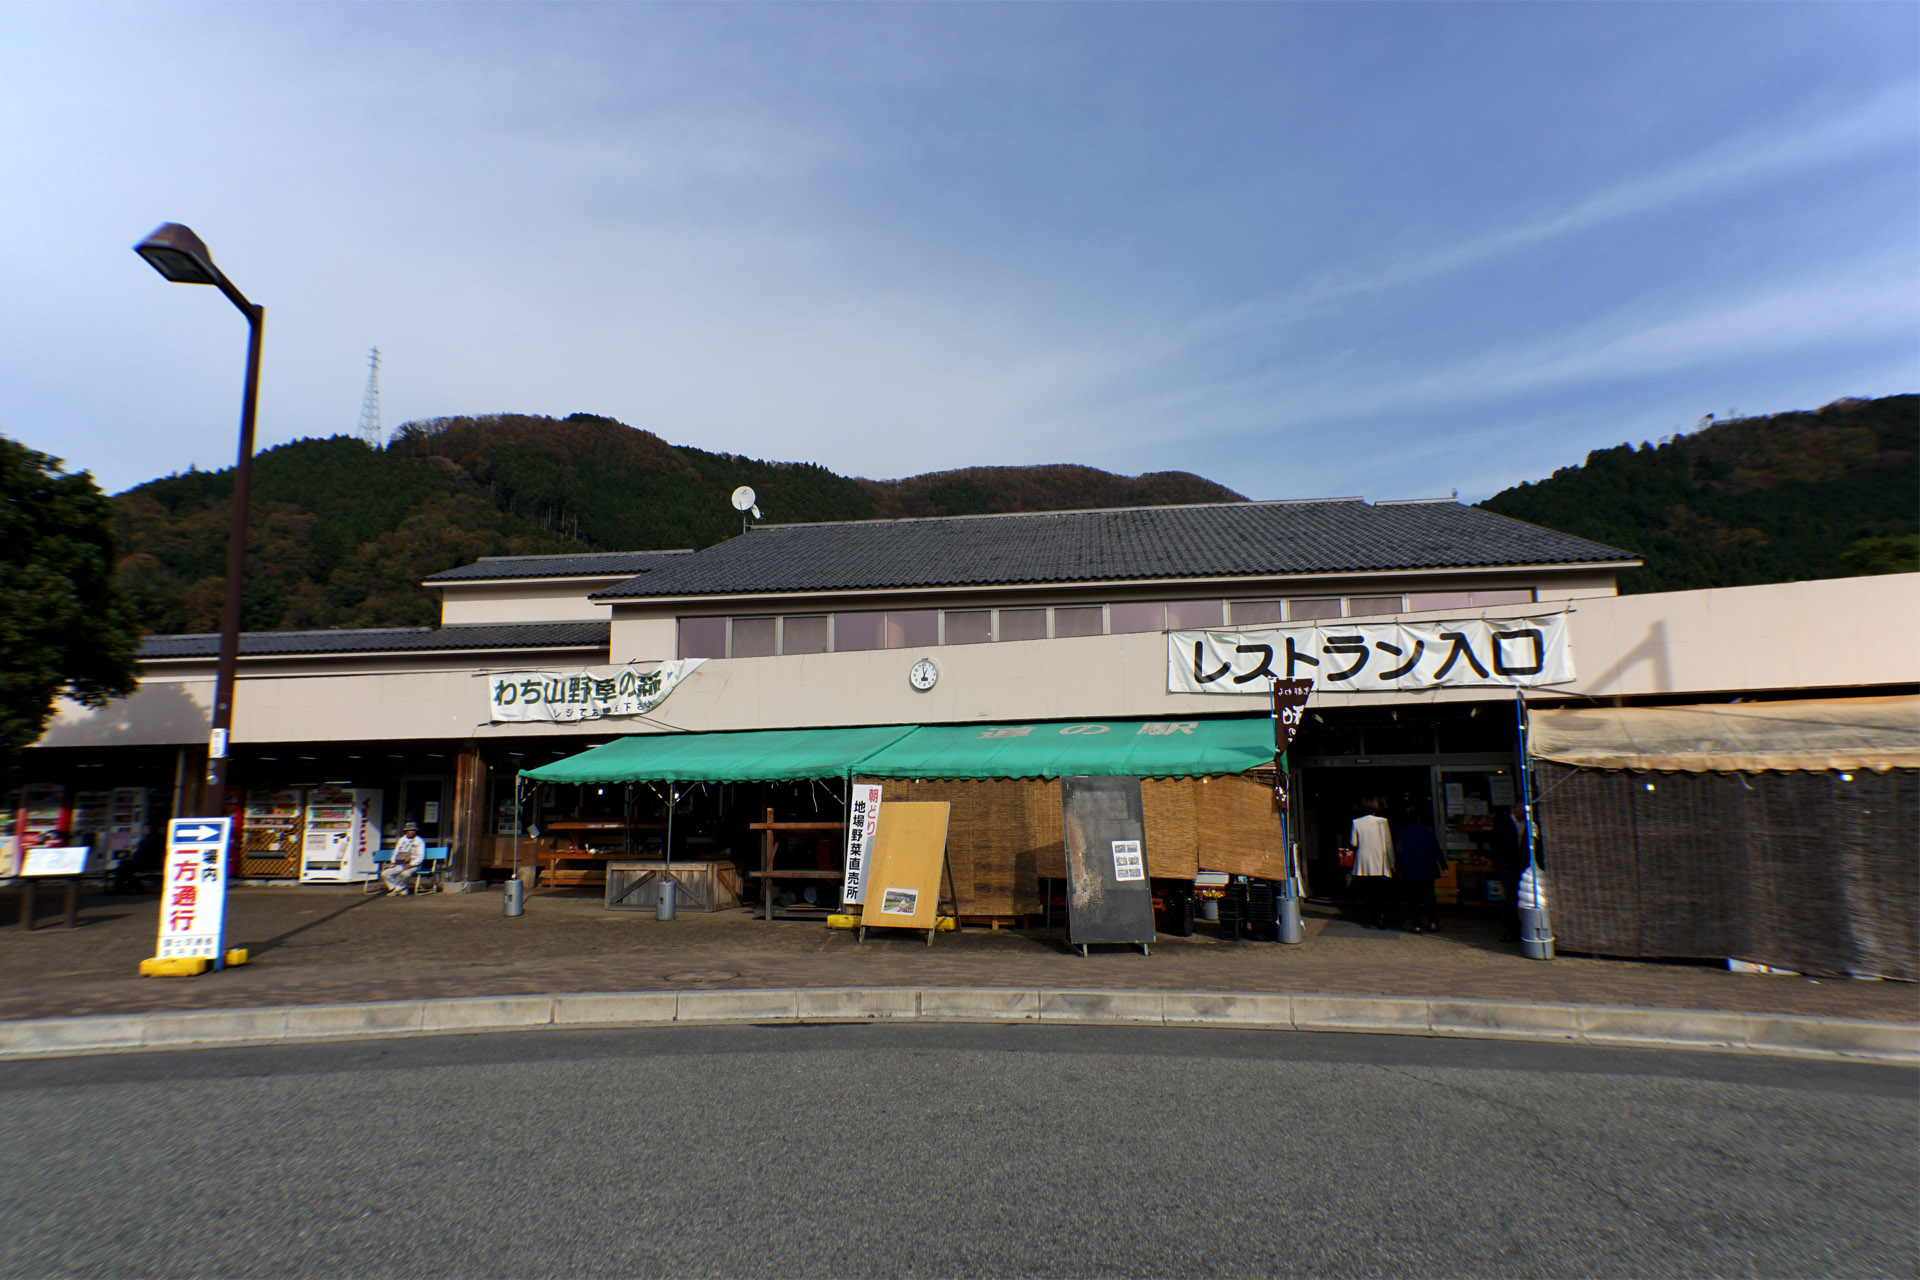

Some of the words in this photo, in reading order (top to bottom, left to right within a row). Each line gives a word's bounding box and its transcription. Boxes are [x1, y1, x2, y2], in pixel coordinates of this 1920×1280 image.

[1194, 629, 1544, 684] レストラン入口
[978, 722, 1199, 739] 道の駅
[358, 797, 371, 857] Yakult
[867, 788, 880, 836] 朝どり
[845, 800, 867, 900] 地場野菜直売所
[169, 849, 200, 931] 一方通行
